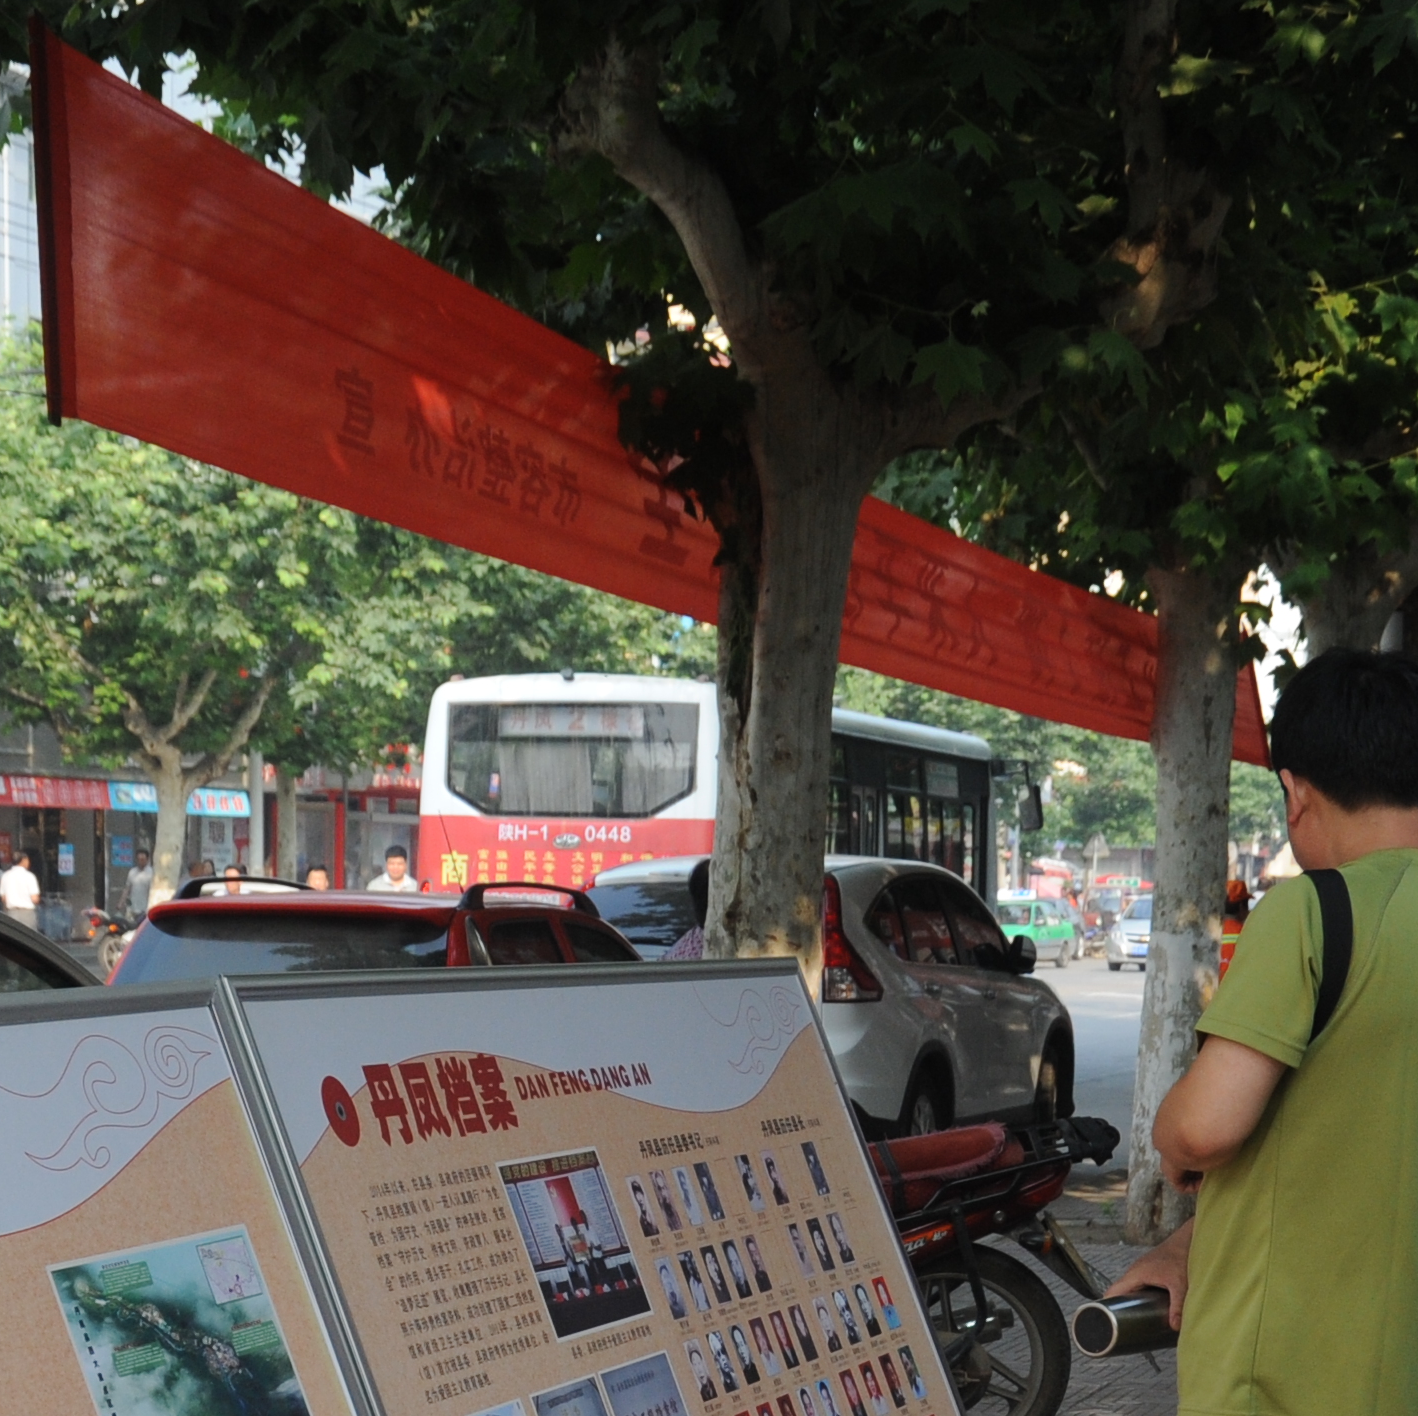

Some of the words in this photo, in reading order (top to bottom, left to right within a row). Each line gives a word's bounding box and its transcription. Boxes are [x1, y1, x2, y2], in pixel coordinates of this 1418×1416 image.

[584, 826, 632, 843] 0448
[441, 851, 469, 886] 商
[361, 1053, 519, 1147] 丹凤档案
[513, 1074, 551, 1101] DAN
[551, 1068, 591, 1097] FENG
[588, 1064, 632, 1092] DANG
[631, 1062, 653, 1087] AN
